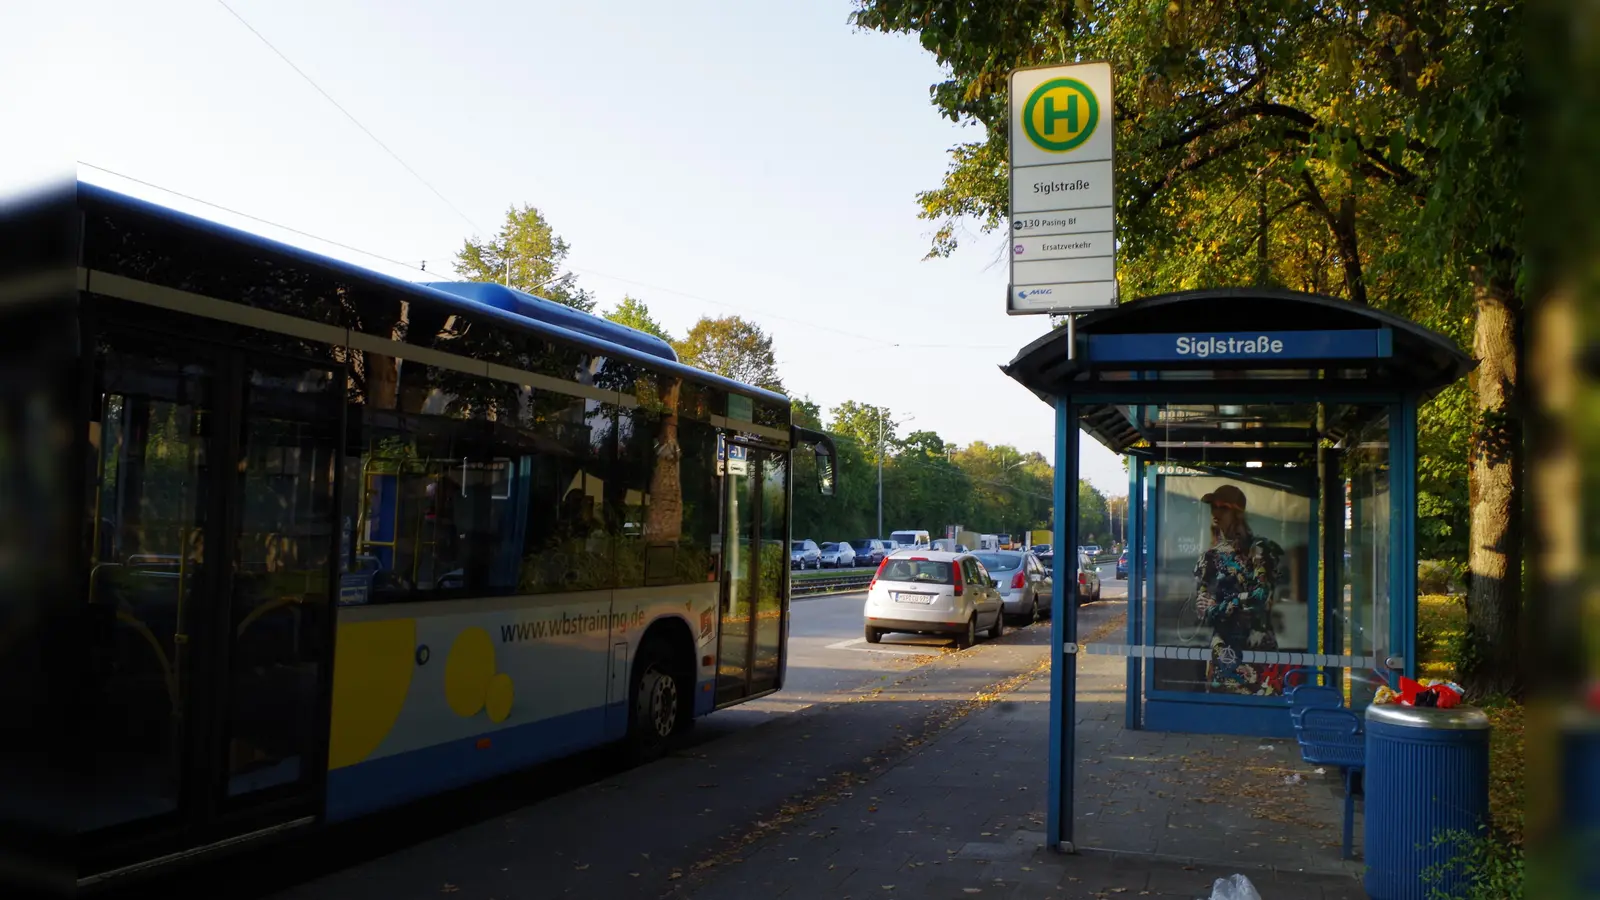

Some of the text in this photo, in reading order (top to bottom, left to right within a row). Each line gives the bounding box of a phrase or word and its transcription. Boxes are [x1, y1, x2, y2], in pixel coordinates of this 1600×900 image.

[1043, 94, 1079, 136] H
[1033, 180, 1090, 195] Siglstraße
[1023, 219, 1040, 228] 130
[1042, 219, 1066, 228] Pasing
[1068, 217, 1077, 226] Bf
[1042, 242, 1092, 252] Ersatzverkehr
[1029, 288, 1052, 296] MVG
[1175, 335, 1284, 358] Siglstraße
[501, 605, 646, 643] www.wbstraining.de
